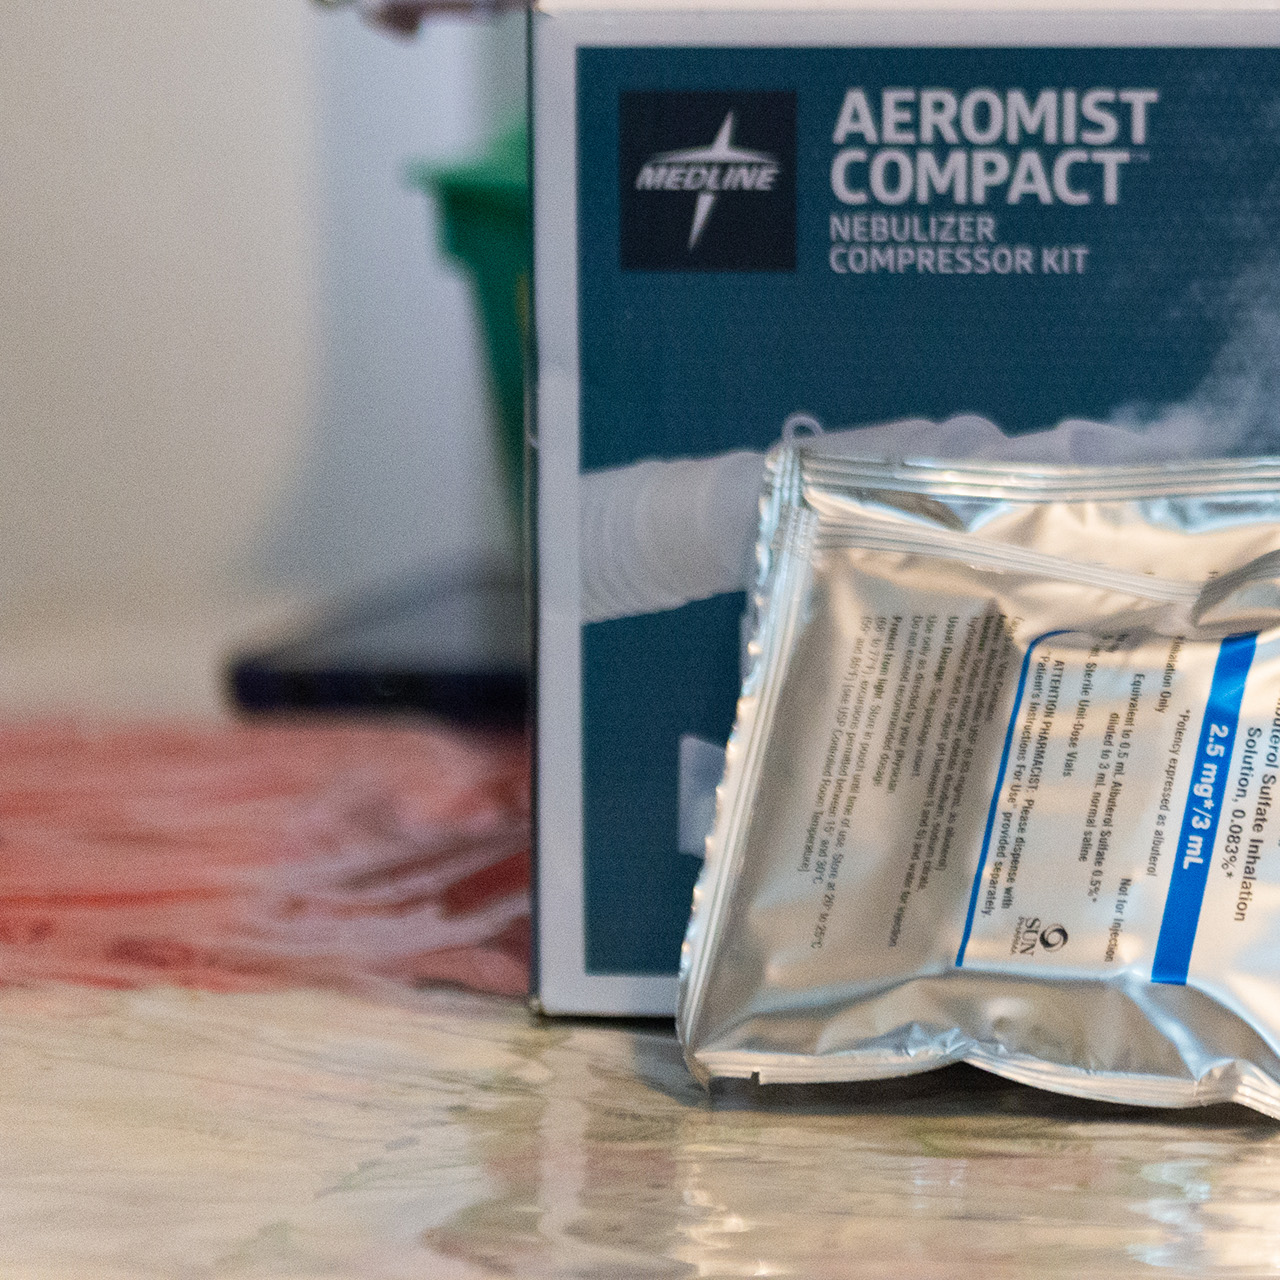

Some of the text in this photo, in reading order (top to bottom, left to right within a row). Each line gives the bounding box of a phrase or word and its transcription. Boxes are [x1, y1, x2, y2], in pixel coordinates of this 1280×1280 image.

[833, 87, 1159, 145] AEROMIST
[636, 165, 779, 191] MEDLINE
[830, 214, 996, 242] NEBULIZER
[830, 246, 1090, 275] COMPRESSOR KIT
[1078, 661, 1097, 697] Sterile
[1121, 671, 1146, 728] Equivalent
[1153, 688, 1172, 715] Only
[1015, 700, 1040, 762] Instructions
[1067, 697, 1089, 749] Unit-Dose
[1120, 727, 1133, 741] to
[1204, 722, 1229, 758] 2.5
[1061, 750, 1078, 779] Vials
[1111, 760, 1126, 780] mL
[1116, 740, 1131, 760] 0.5
[1231, 725, 1262, 805] Solution,
[999, 659, 1066, 911] ATTENTION PHARMACIST: Please dispense with
[1011, 762, 1026, 783] For
[1077, 711, 1121, 864] diluted to 3 mL normal saline
[1156, 756, 1181, 812] expressed
[1101, 780, 1122, 829] Albuterol
[1155, 813, 1166, 827] as
[1250, 772, 1277, 834] Sulfate
[992, 810, 1015, 859] provided
[1092, 828, 1112, 868] Sulfate
[1144, 828, 1166, 877] albuterol
[1181, 833, 1207, 873] mL
[1233, 837, 1264, 924] Inhalation
[1017, 915, 1041, 957] SUN
[1101, 876, 1132, 964] Not for Injection
